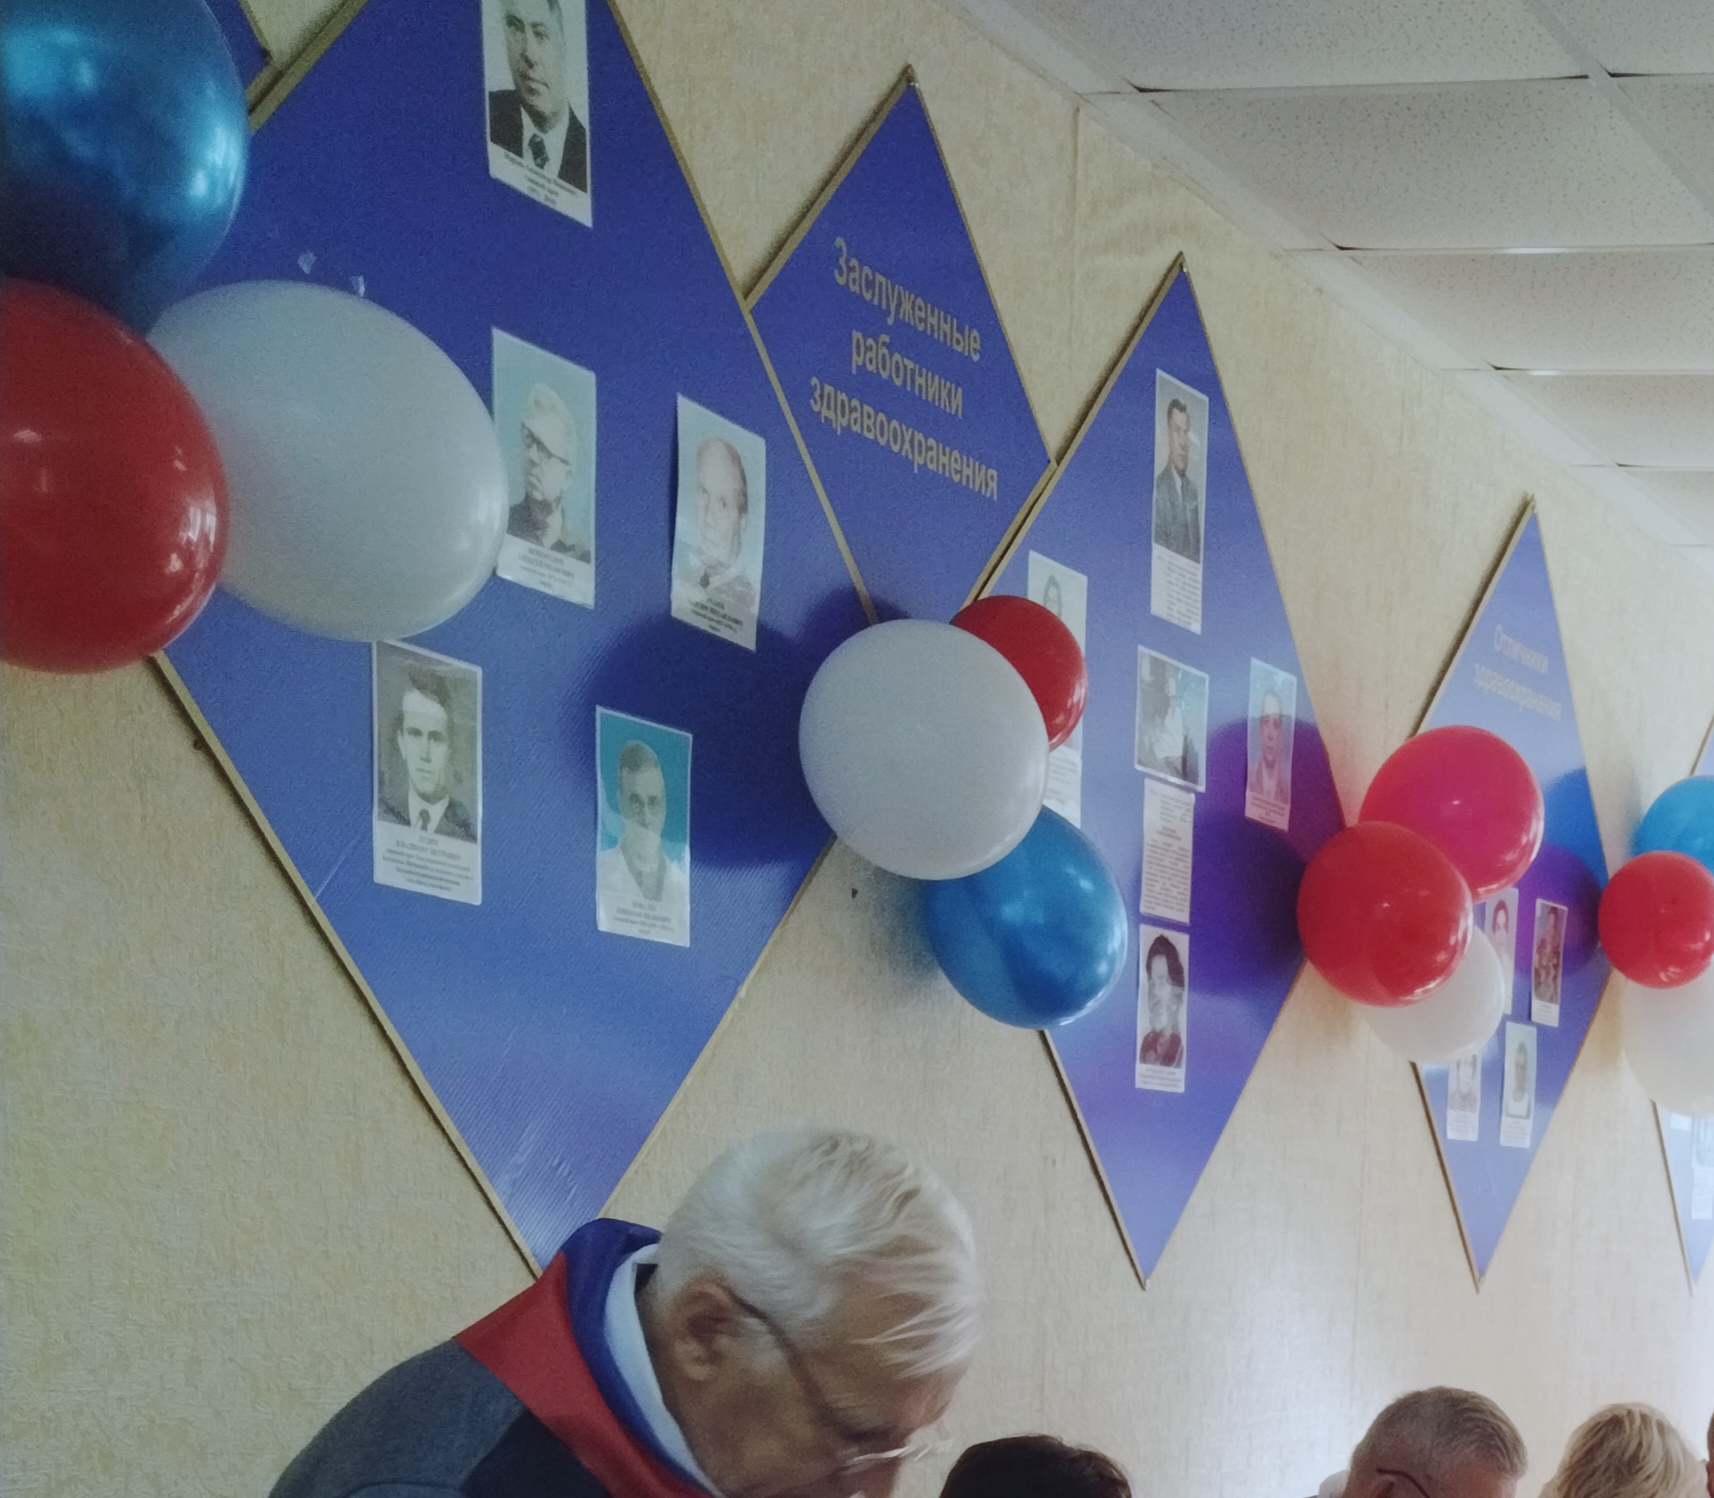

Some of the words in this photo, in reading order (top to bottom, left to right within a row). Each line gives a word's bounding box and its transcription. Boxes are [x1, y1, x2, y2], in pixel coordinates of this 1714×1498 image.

[833, 236, 981, 362] Заслуженные
[851, 330, 964, 419] работники
[809, 375, 998, 501] здравоохранения
